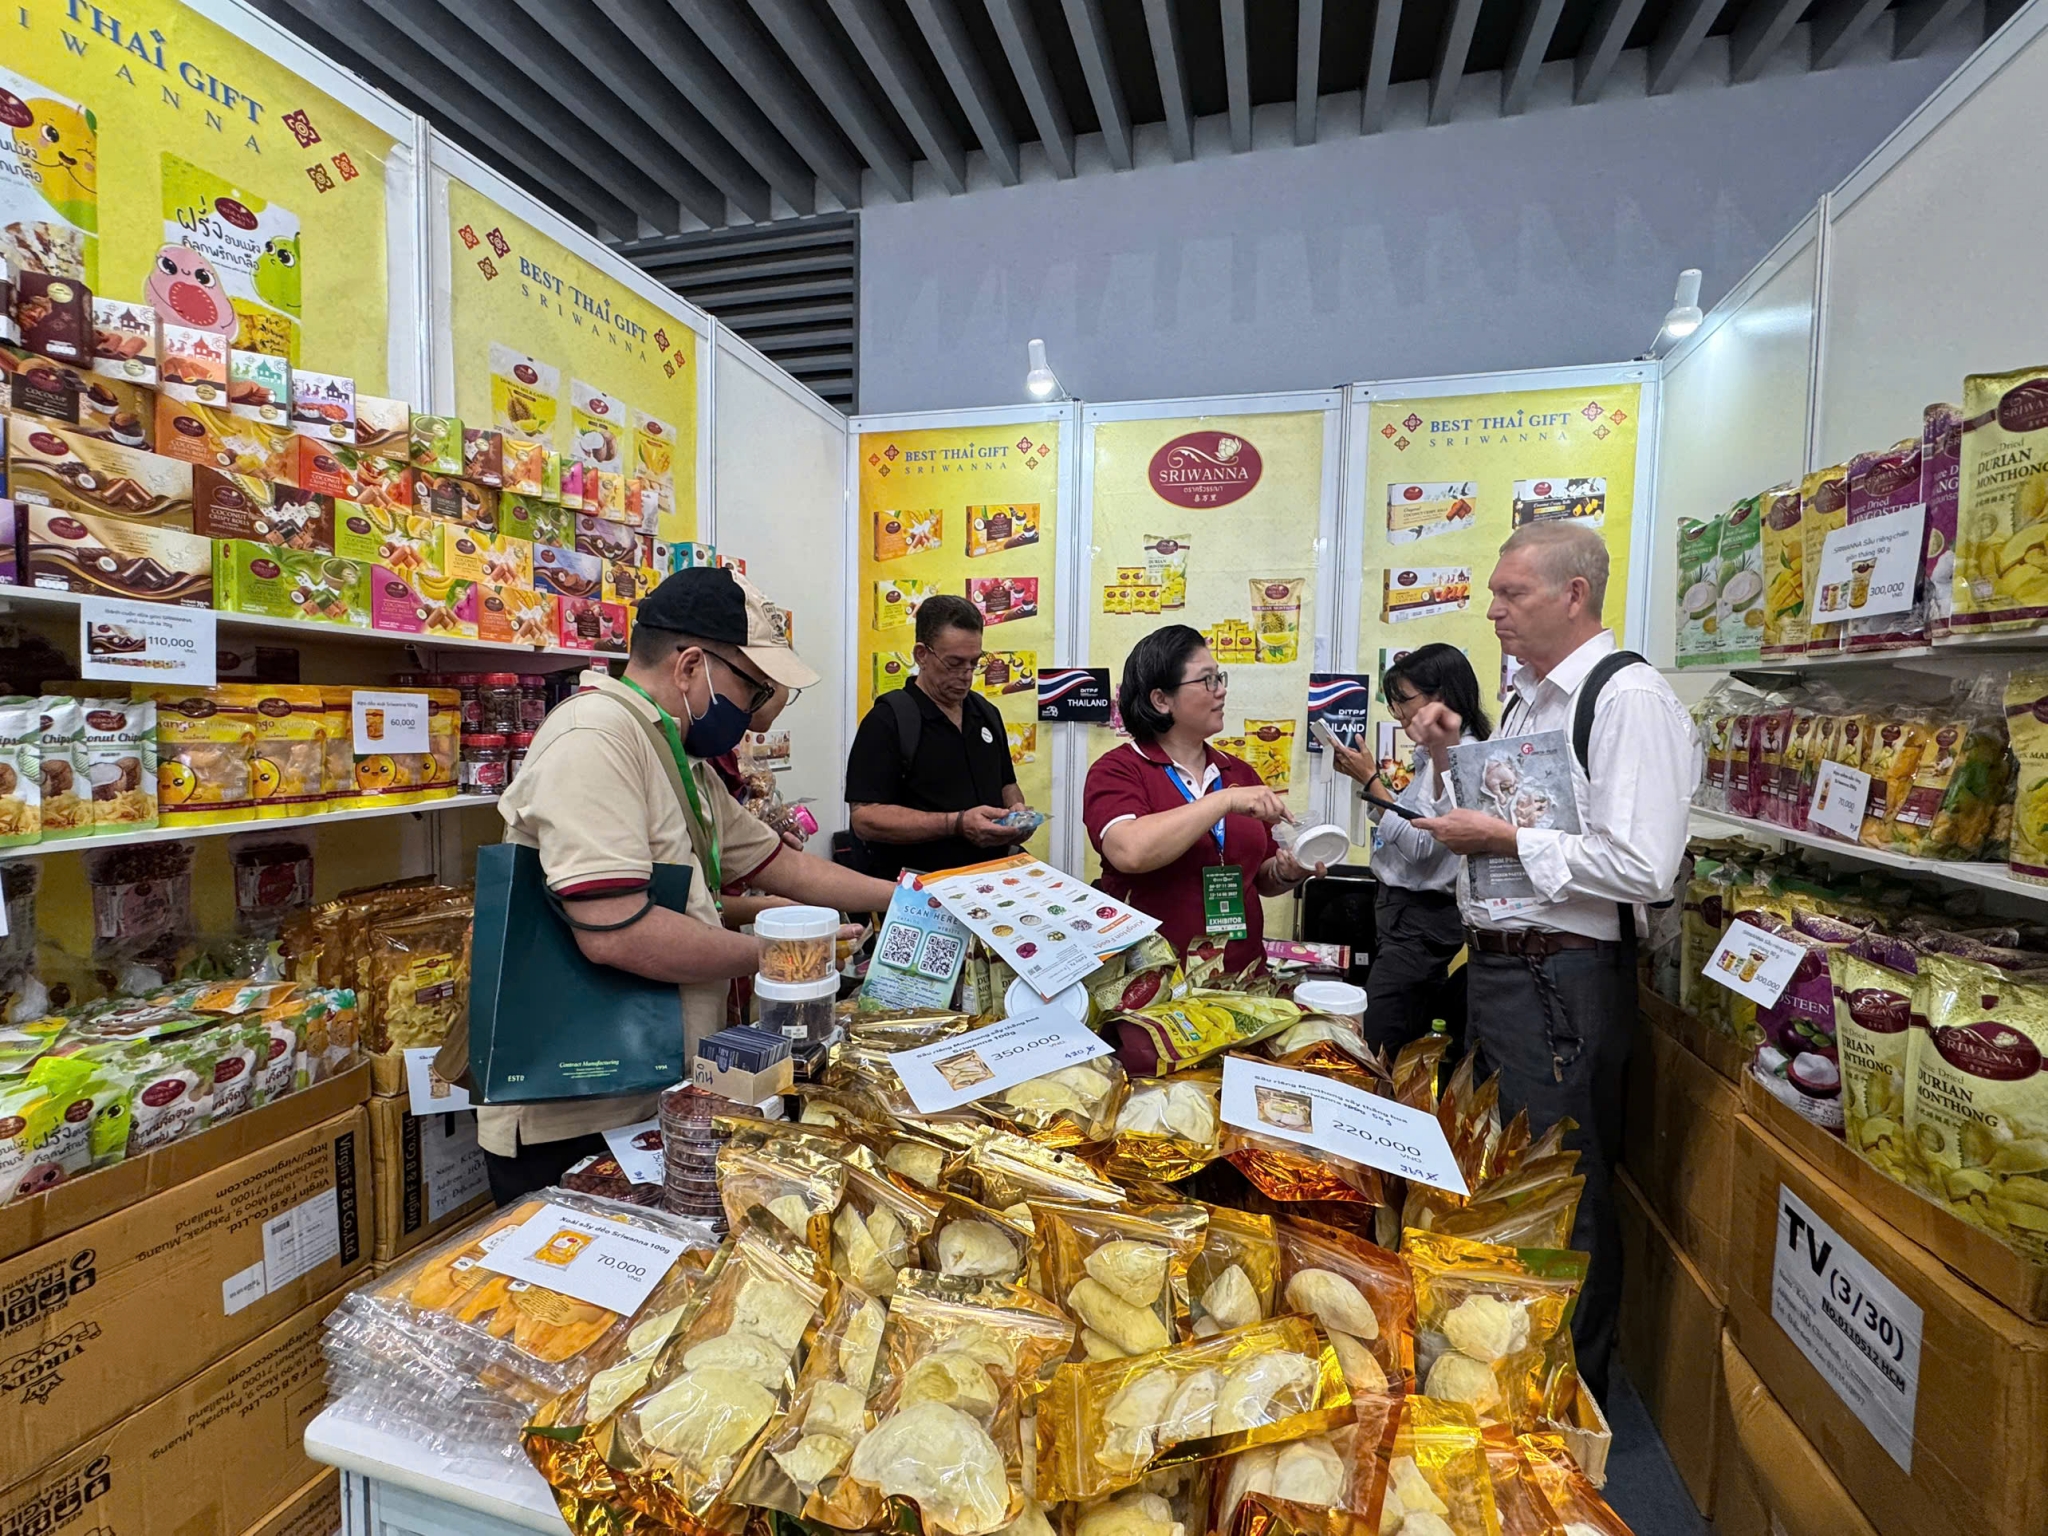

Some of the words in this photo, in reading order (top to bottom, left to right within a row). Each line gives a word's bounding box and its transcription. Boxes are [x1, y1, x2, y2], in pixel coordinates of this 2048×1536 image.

[180, 61, 264, 125] GIFT
[519, 256, 564, 295] BEST
[615, 314, 648, 344] GIFT
[1430, 420, 1472, 432] BEST
[1528, 413, 1570, 427] GIFT
[1430, 432, 1568, 448] SRIWANNA
[905, 449, 936, 463] BEST
[978, 446, 1008, 460] GIFT
[1978, 449, 2033, 475] DURIAN
[905, 462, 1008, 474] SRIWANNA
[1160, 467, 1248, 482] SRIWANNA
[1867, 496, 1890, 510] Dried
[209, 514, 231, 522] CRISPY
[211, 509, 247, 519] COCONUT
[1869, 582, 1905, 597] 300,000
[148, 636, 194, 648] 110,000
[1068, 699, 1108, 707] THAILAND
[390, 719, 415, 727] 60,000
[0, 736, 16, 746] ips
[1837, 797, 1855, 810] 70,000
[904, 906, 930, 917] SCAN
[934, 914, 958, 925] HERE
[1209, 917, 1242, 926] EXHIBITOR
[1093, 936, 1116, 949] Foods
[1754, 974, 1780, 990] 300,000
[953, 1032, 990, 1050] Monthong
[1025, 1016, 1040, 1024] hoa
[952, 1038, 994, 1054] Sriwanna
[994, 1031, 1016, 1042] 100g
[991, 1034, 1060, 1061] 350,000
[1938, 1036, 2025, 1068] SRIWANNA
[1938, 1066, 1964, 1085] Dried
[1298, 1084, 1344, 1102] Monthong
[1390, 1113, 1408, 1124] hoa
[1300, 1090, 1342, 1106] Sriwanna
[1820, 1114, 1837, 1125] 220
[1823, 1108, 1834, 1116] 85
[1333, 1119, 1421, 1157] 220,000
[338, 1136, 351, 1175] Virgin
[216, 1142, 328, 1198] http://virgincoco.com
[263, 1154, 328, 1189] Kanchanaburi
[406, 1160, 416, 1172] B
[300, 1179, 329, 1197] Virgin
[342, 1178, 351, 1186] F
[406, 1175, 418, 1186] &
[231, 1184, 262, 1206] 71000
[270, 1182, 297, 1198] 19/99
[290, 1193, 297, 1201] F
[342, 1189, 351, 1199] &
[407, 1186, 416, 1194] F
[245, 1196, 268, 1211] Moo
[271, 1204, 278, 1212] B
[280, 1199, 288, 1207] &
[343, 1200, 352, 1211] B
[175, 1204, 224, 1234] Thailand
[233, 1208, 242, 1217] 9,
[407, 1195, 420, 1231] Virgin
[611, 1230, 650, 1247] Sriwanna
[650, 1242, 670, 1254] 100g
[34, 1258, 66, 1276] HANDLE
[598, 1253, 647, 1277] 70,000
[2, 1274, 31, 1291] WITH
[2, 1267, 65, 1307] FRAGI
[1784, 1203, 1832, 1278] TV
[1830, 1268, 1904, 1362] (3/30)
[43, 1300, 68, 1318] KEEP
[4, 1315, 41, 1339] BELOW
[0, 1344, 85, 1396] VIRGIN
[280, 1355, 307, 1373] 19/99
[302, 1368, 308, 1376] F
[242, 1368, 273, 1389] 71000
[256, 1375, 279, 1392] Moo
[291, 1374, 298, 1382] &
[1880, 1360, 1906, 1392] HCM
[282, 1382, 289, 1390] B
[187, 1389, 235, 1425] Thailand
[0, 1477, 79, 1529] FRAGIL
